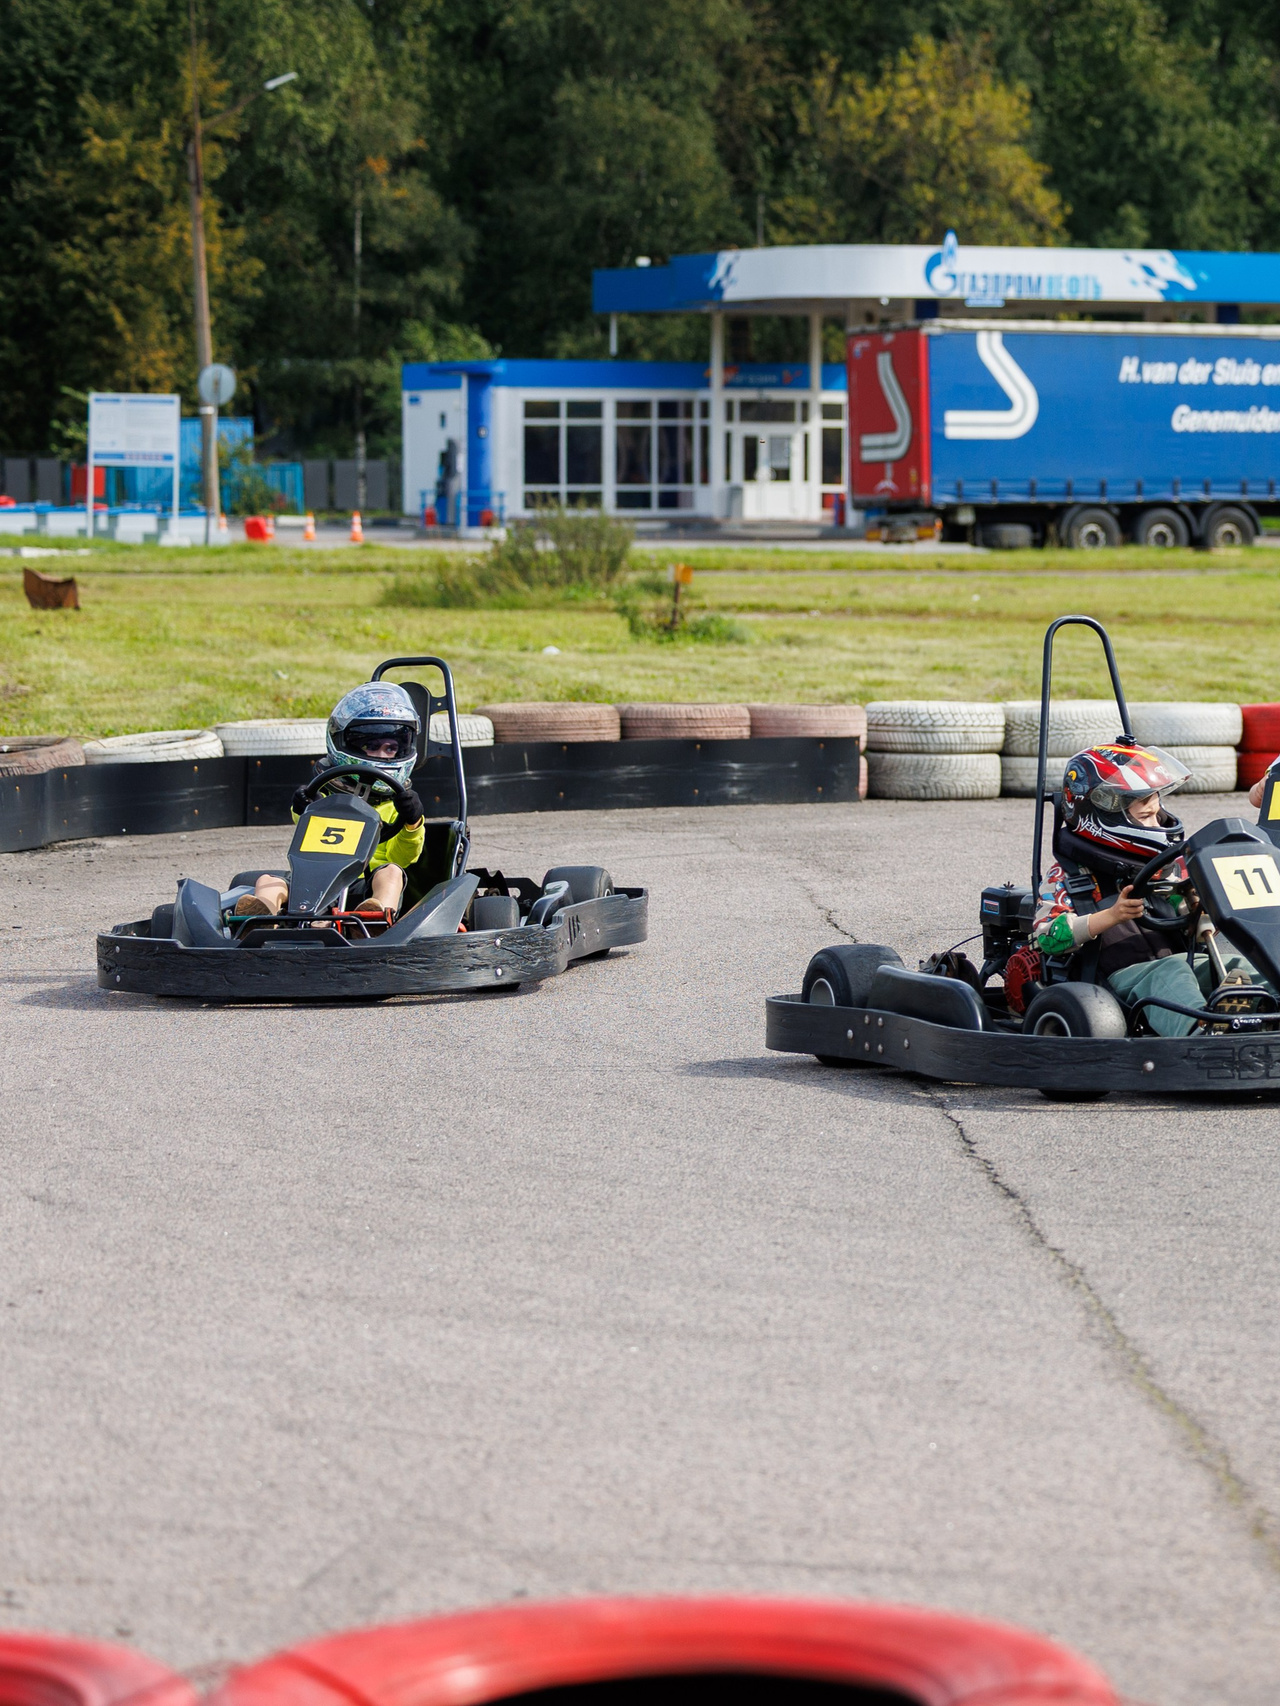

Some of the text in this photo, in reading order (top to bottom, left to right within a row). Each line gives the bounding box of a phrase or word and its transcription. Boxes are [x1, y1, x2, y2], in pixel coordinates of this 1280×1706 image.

[1119, 356, 1141, 383] H.
[1142, 362, 1178, 384] van
[1178, 357, 1213, 385] der
[1213, 357, 1261, 386] Sluis
[320, 827, 346, 845] 5
[1234, 868, 1273, 895] 11
